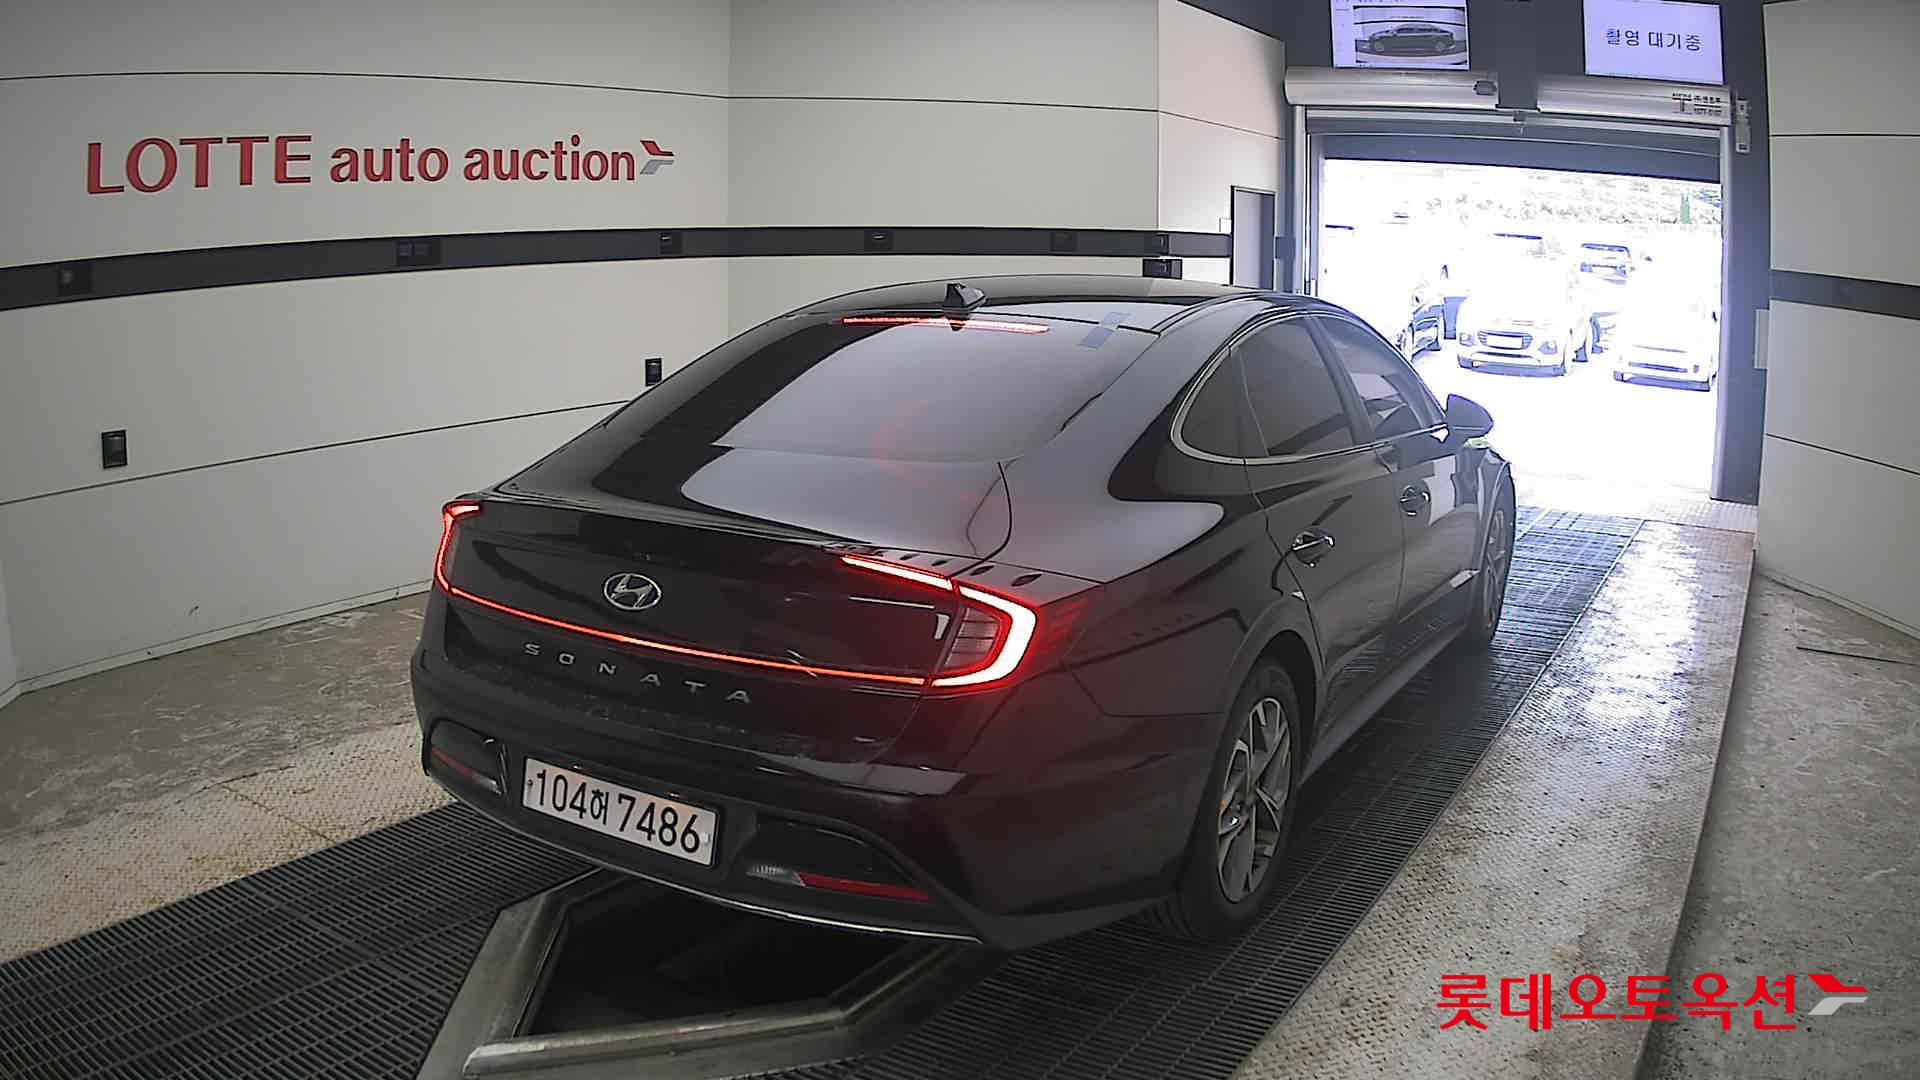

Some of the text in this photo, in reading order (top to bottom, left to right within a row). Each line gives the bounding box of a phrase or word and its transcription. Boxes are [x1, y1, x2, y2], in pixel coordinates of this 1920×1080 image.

[87, 134, 636, 194] LOTTE auto auction
[525, 643, 750, 704] SONATA
[617, 792, 701, 854] 7486
